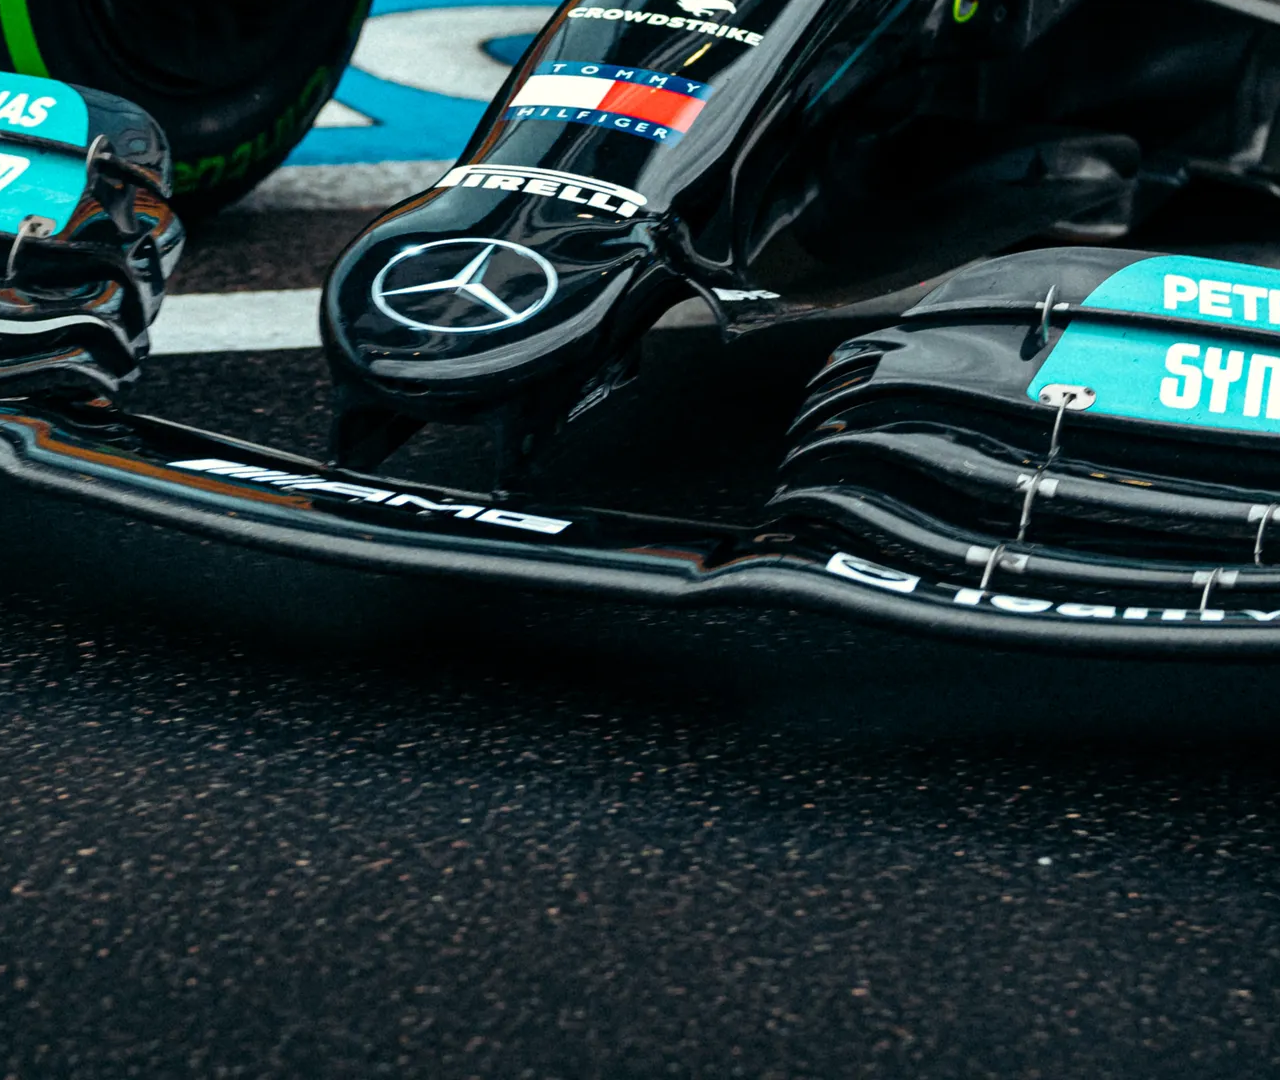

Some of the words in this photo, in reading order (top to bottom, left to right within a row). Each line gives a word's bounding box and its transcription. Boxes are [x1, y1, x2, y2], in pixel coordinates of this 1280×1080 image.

[567, 6, 765, 47] CROWDSTRIKE
[552, 62, 701, 93] TOMMY
[516, 106, 668, 140] HILFIGER
[434, 163, 648, 218] PIRELLI
[280, 475, 573, 534] AMG
